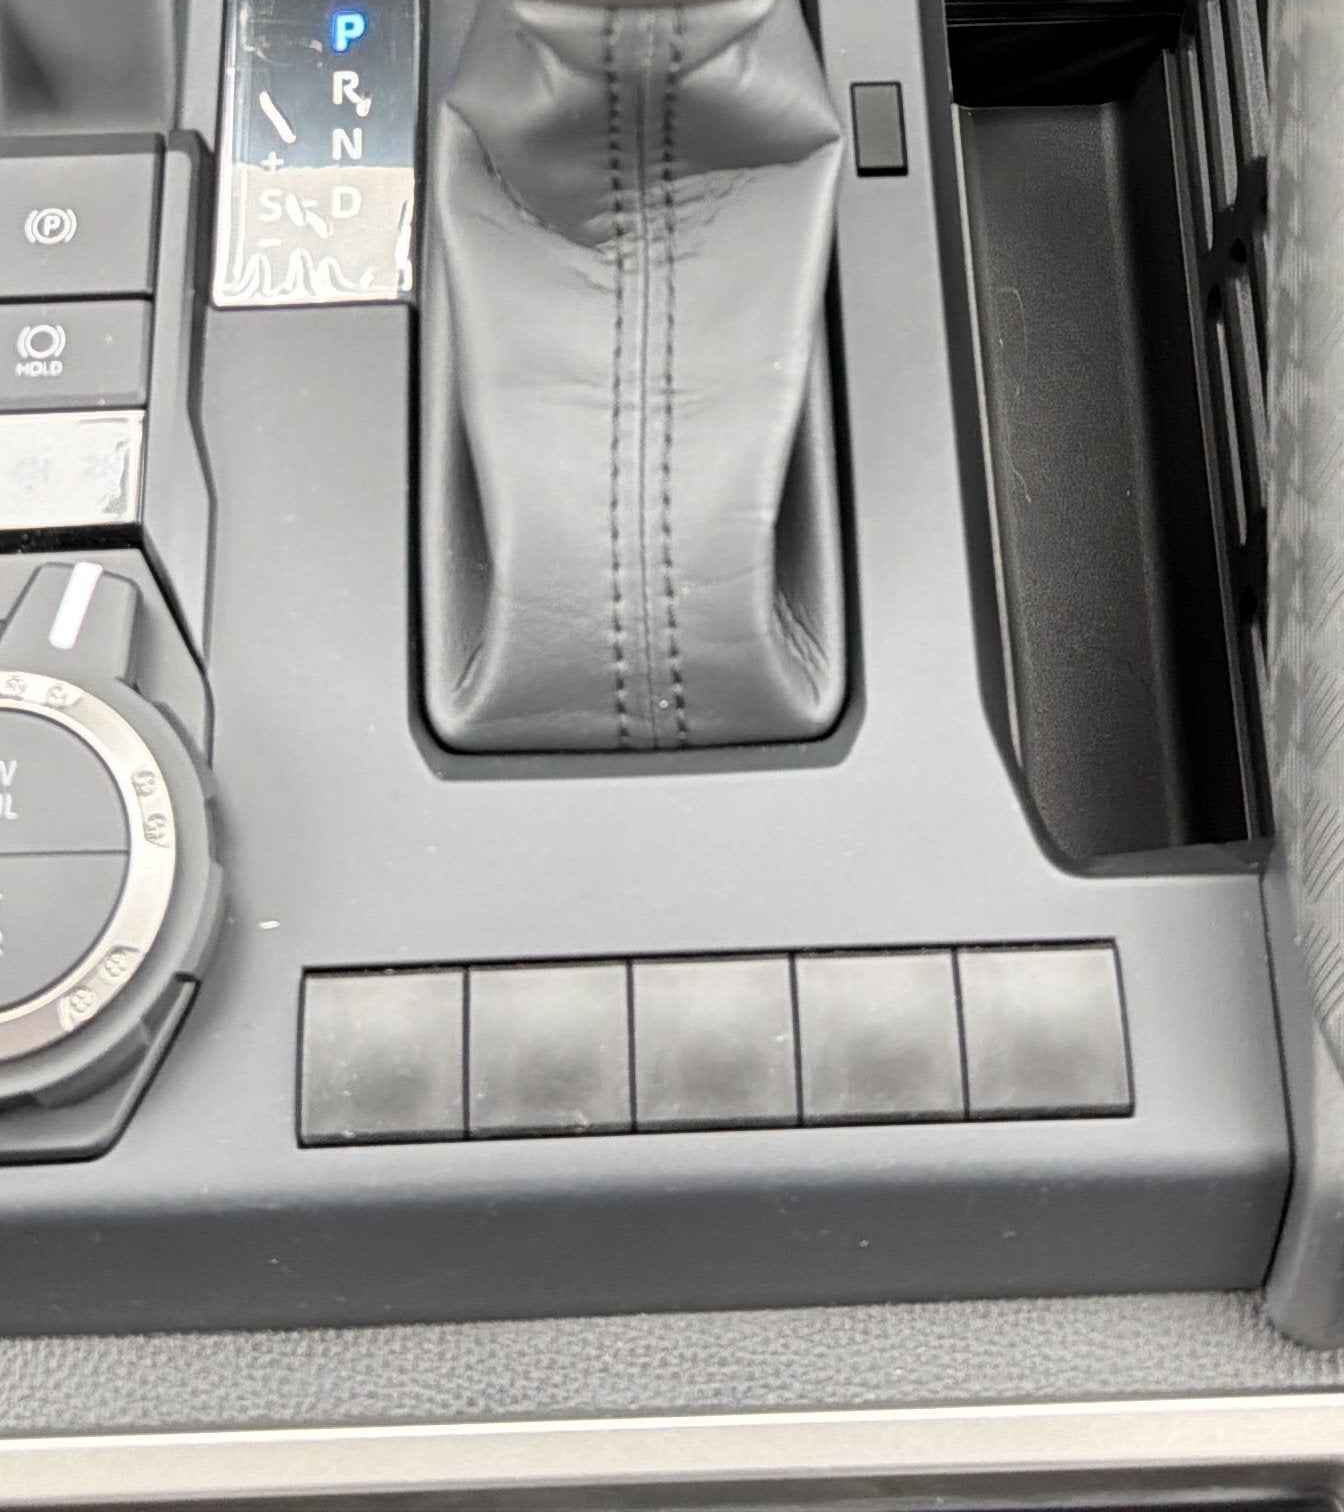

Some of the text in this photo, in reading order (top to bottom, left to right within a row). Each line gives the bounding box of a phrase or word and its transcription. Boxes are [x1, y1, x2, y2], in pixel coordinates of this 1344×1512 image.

[332, 11, 366, 52] P
[332, 71, 365, 104] R
[332, 128, 364, 159] N
[259, 189, 282, 222] S
[331, 187, 362, 219] D
[16, 361, 64, 377] HOLD
